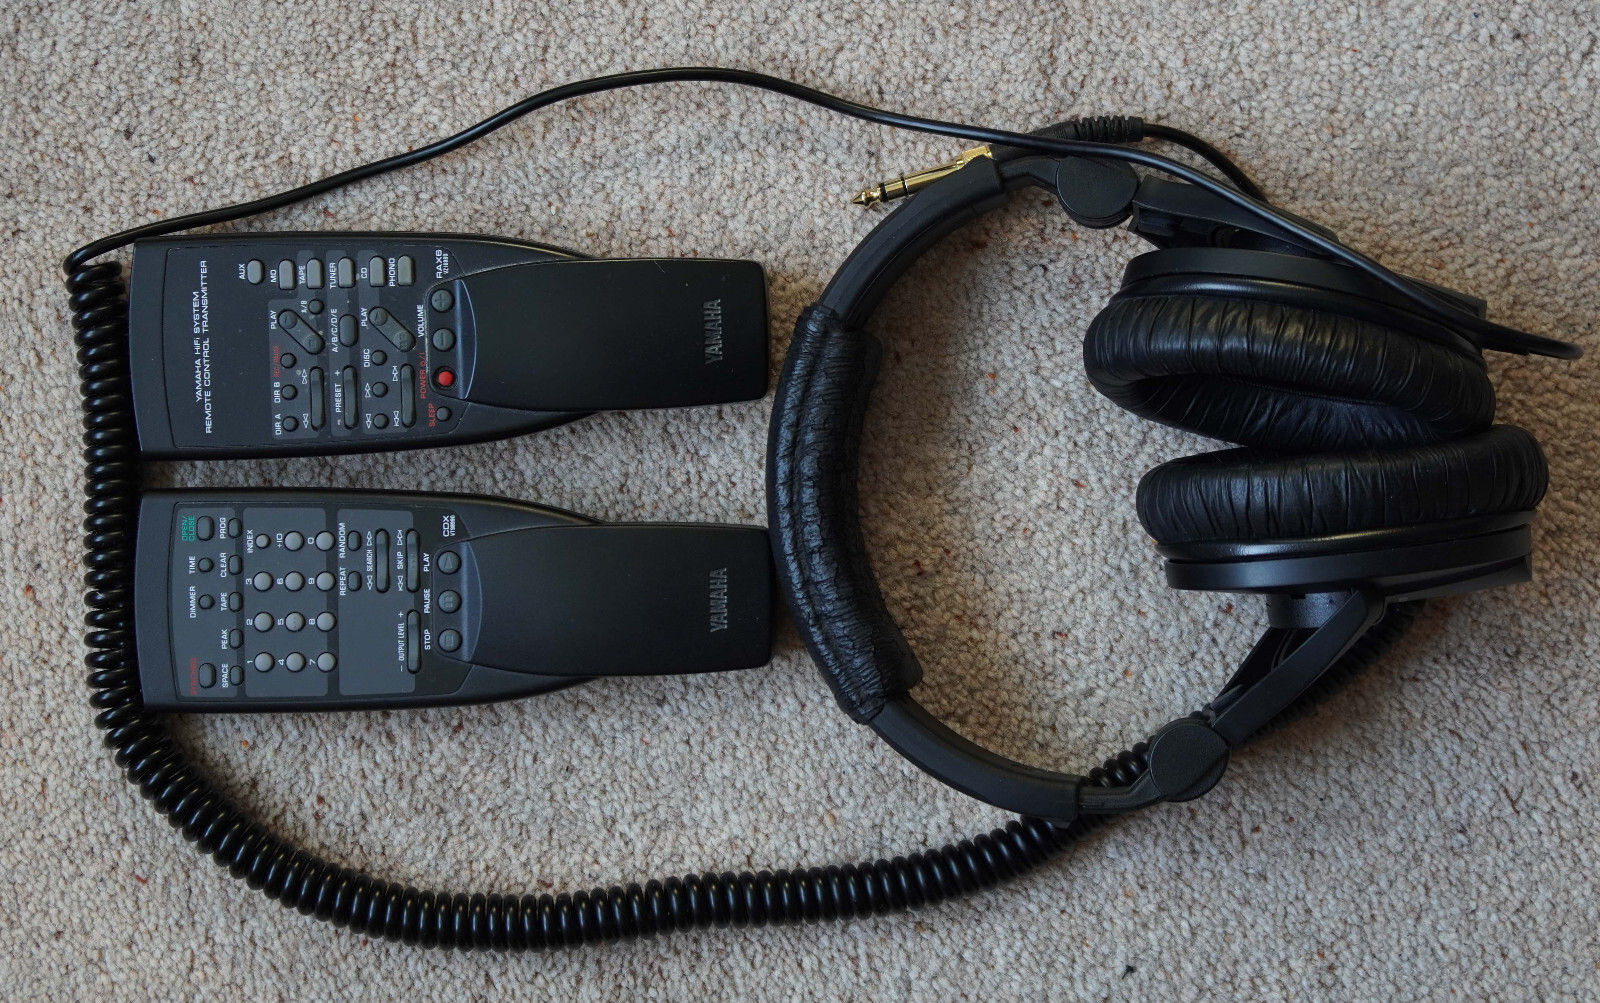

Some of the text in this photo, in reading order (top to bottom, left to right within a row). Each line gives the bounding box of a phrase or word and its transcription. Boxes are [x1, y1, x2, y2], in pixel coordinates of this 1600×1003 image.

[361, 268, 367, 278] CD
[417, 305, 425, 337] VOLUME
[703, 298, 723, 364] YAMAHA
[709, 567, 728, 633] YAMAHA
